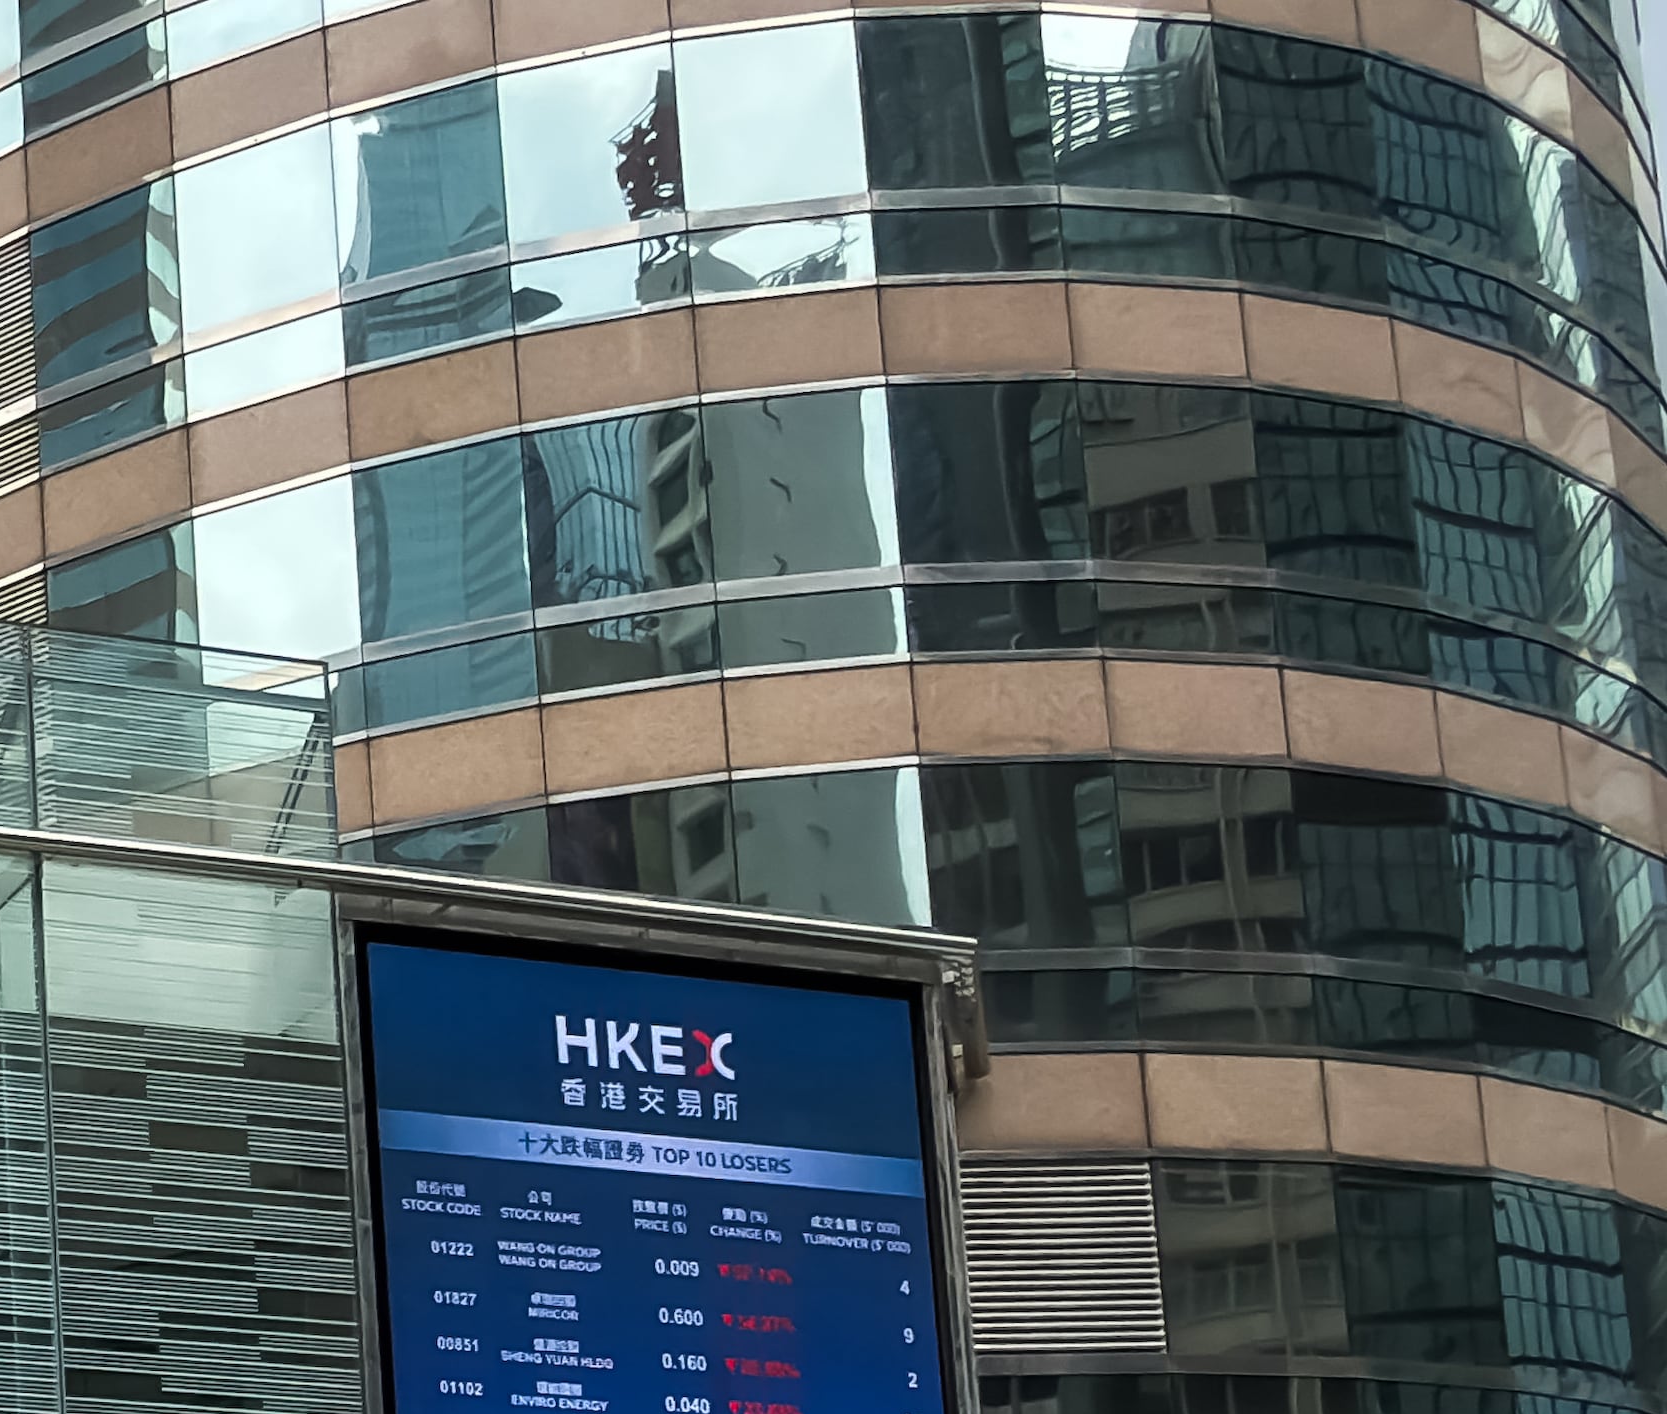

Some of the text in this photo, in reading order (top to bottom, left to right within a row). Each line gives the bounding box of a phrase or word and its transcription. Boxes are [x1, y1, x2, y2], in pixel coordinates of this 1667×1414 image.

[556, 1016, 735, 1080] HKEX
[561, 1078, 737, 1120] 香港交易所
[651, 1145, 689, 1165] TOP
[695, 1150, 714, 1168] 10
[720, 1152, 793, 1175] LOSERS
[401, 1198, 482, 1217] STOCK CODE
[499, 1206, 542, 1222] STOCK
[430, 1240, 474, 1257] 01222
[498, 1253, 537, 1268] WANG
[654, 1258, 700, 1277] 0.009
[900, 1280, 910, 1295] 4
[658, 1307, 704, 1327] 0.600
[903, 1327, 915, 1344] 9
[661, 1352, 708, 1372] 0.160
[439, 1379, 484, 1397] 01102
[907, 1372, 918, 1389] 2
